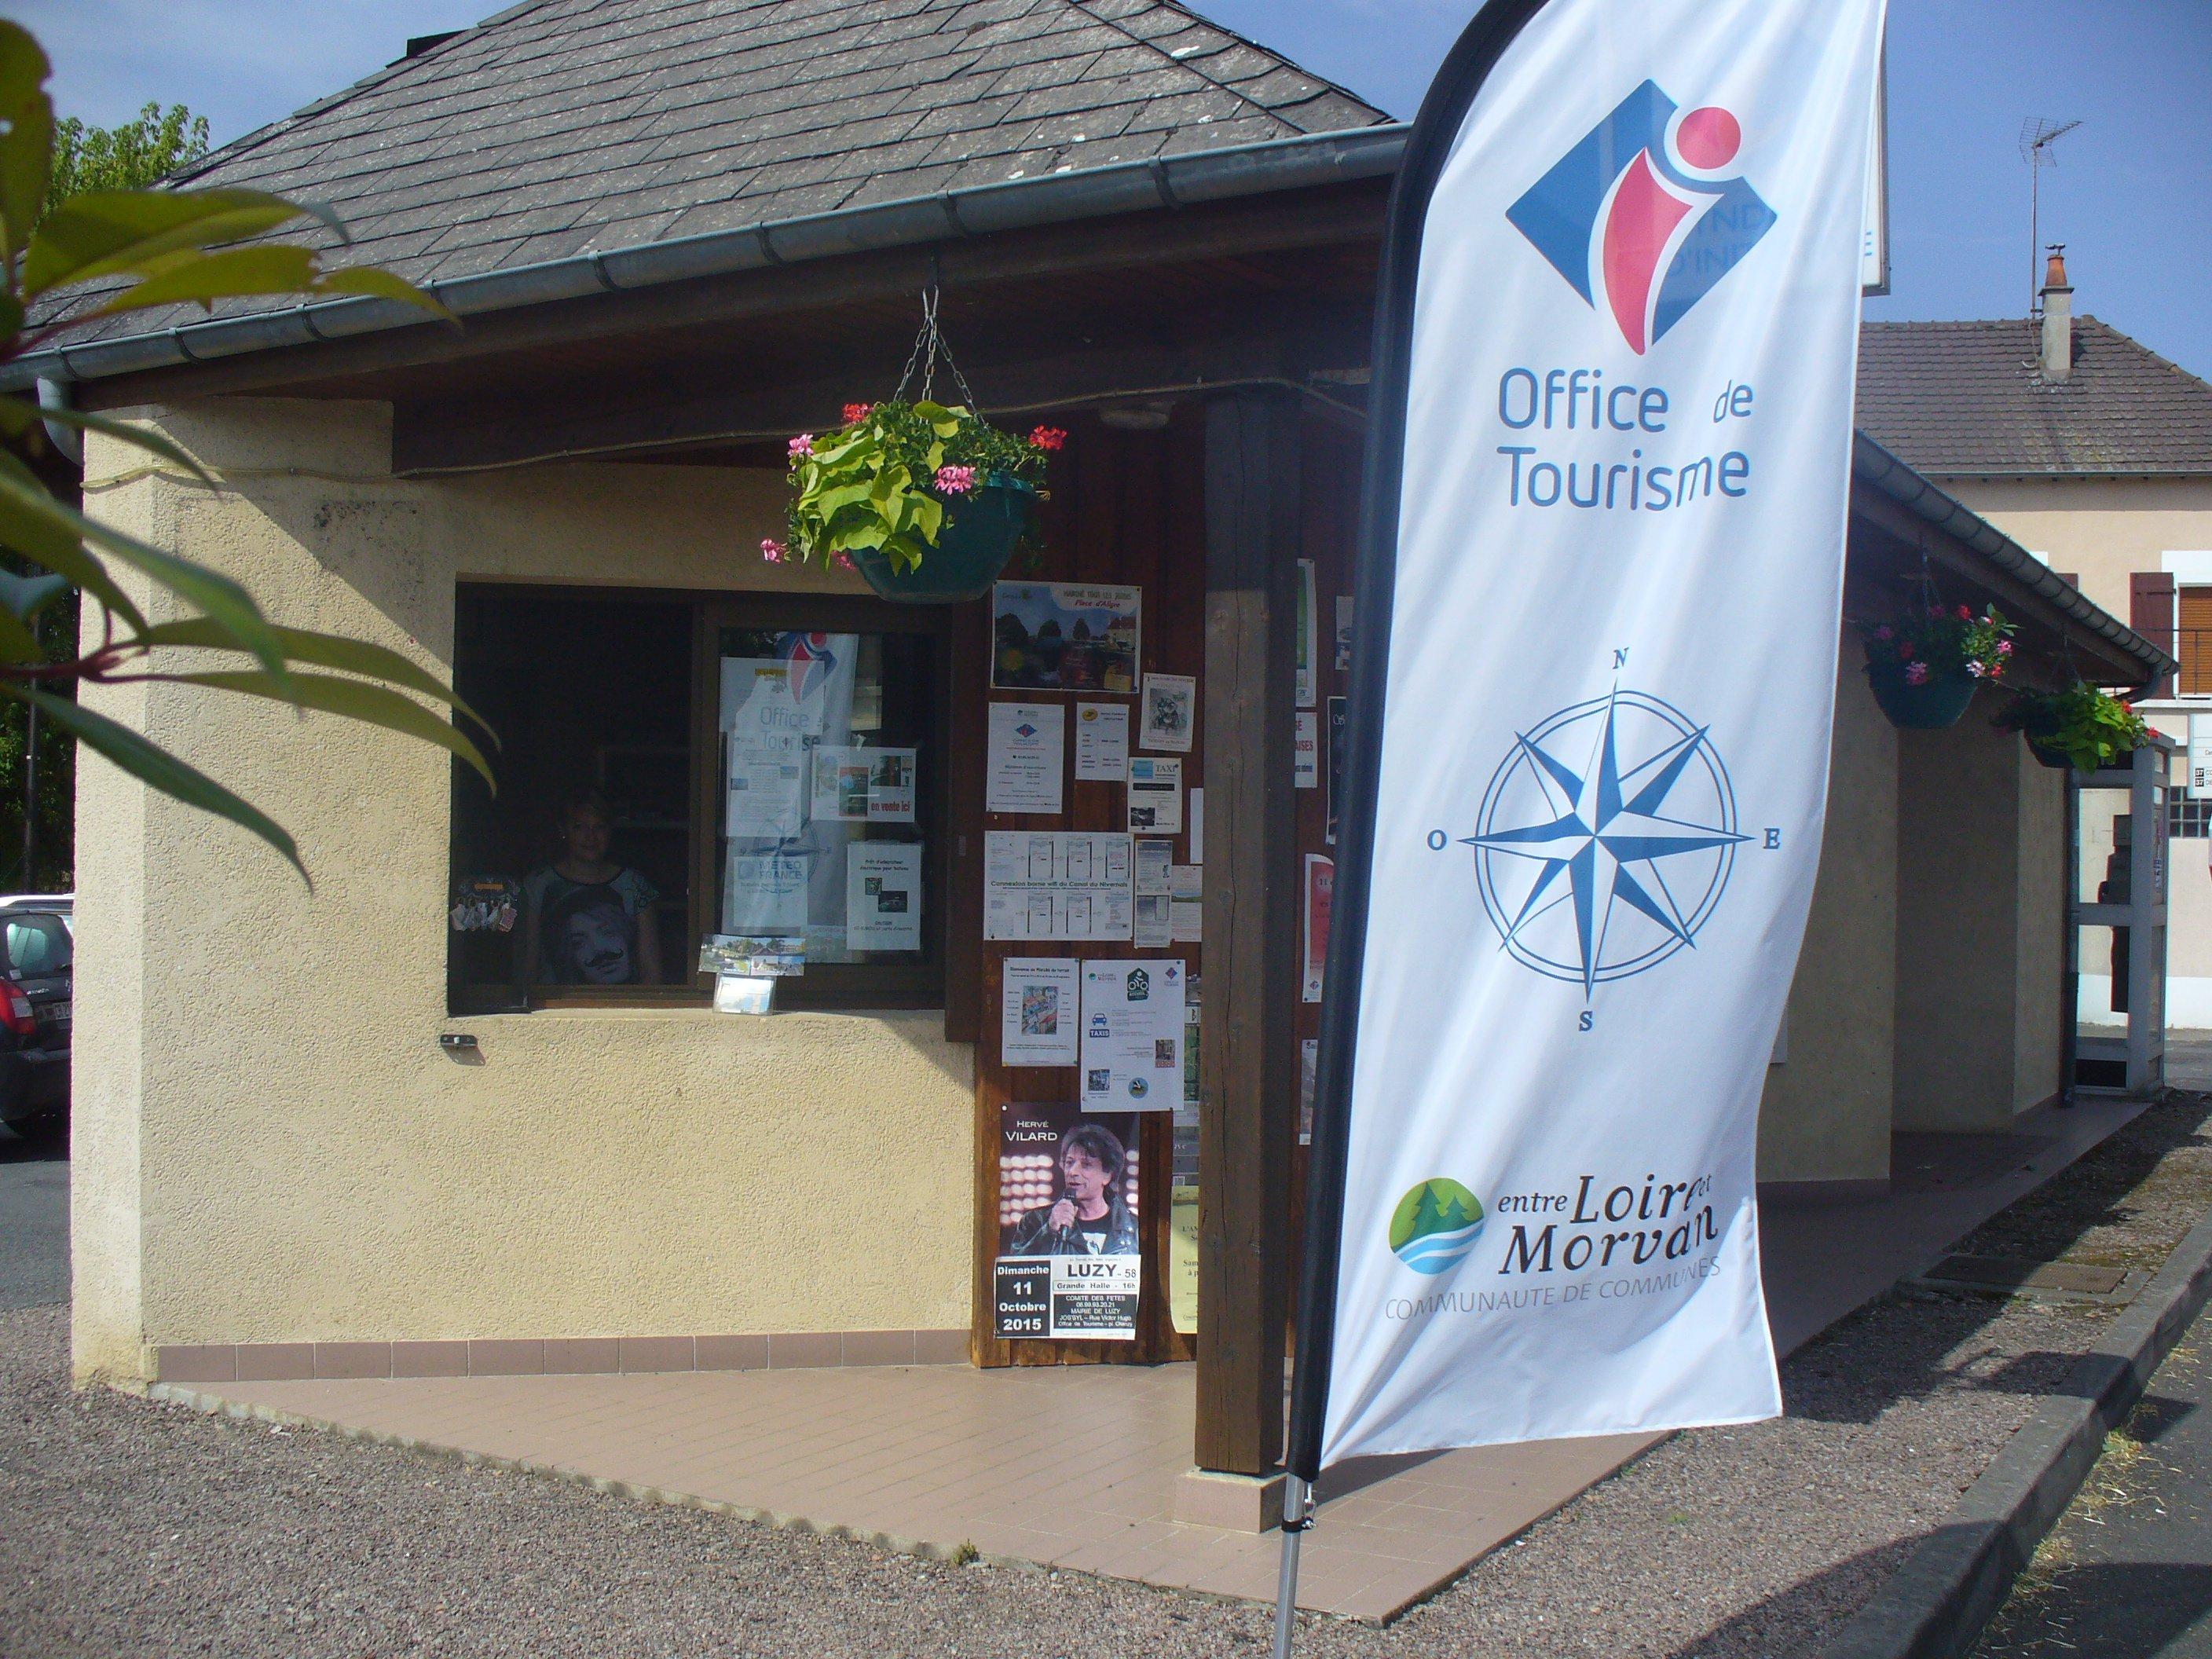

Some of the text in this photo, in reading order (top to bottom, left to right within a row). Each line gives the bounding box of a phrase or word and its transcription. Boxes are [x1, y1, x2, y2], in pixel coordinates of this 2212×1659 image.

[1498, 368, 1753, 432] Office de
[1496, 445, 1750, 511] Tourisme
[1612, 648, 1629, 669] N
[1156, 764, 1175, 773] TAXI
[1426, 829, 1781, 851] O E
[1578, 1010, 1594, 1032] S
[1005, 1130, 1058, 1141] VILARD
[1498, 1192, 1568, 1214] entre
[1498, 1205, 1718, 1275] Morvan
[997, 1265, 1049, 1276] Dimanche
[1068, 1264, 1117, 1277] LUZY
[1124, 1269, 1137, 1279] 58
[1013, 1281, 1032, 1295] 11
[1385, 1256, 1722, 1320] COMMUNAUTE DE COMMUNES
[999, 1302, 1047, 1312] Octobre
[1003, 1318, 1042, 1331] 2015
